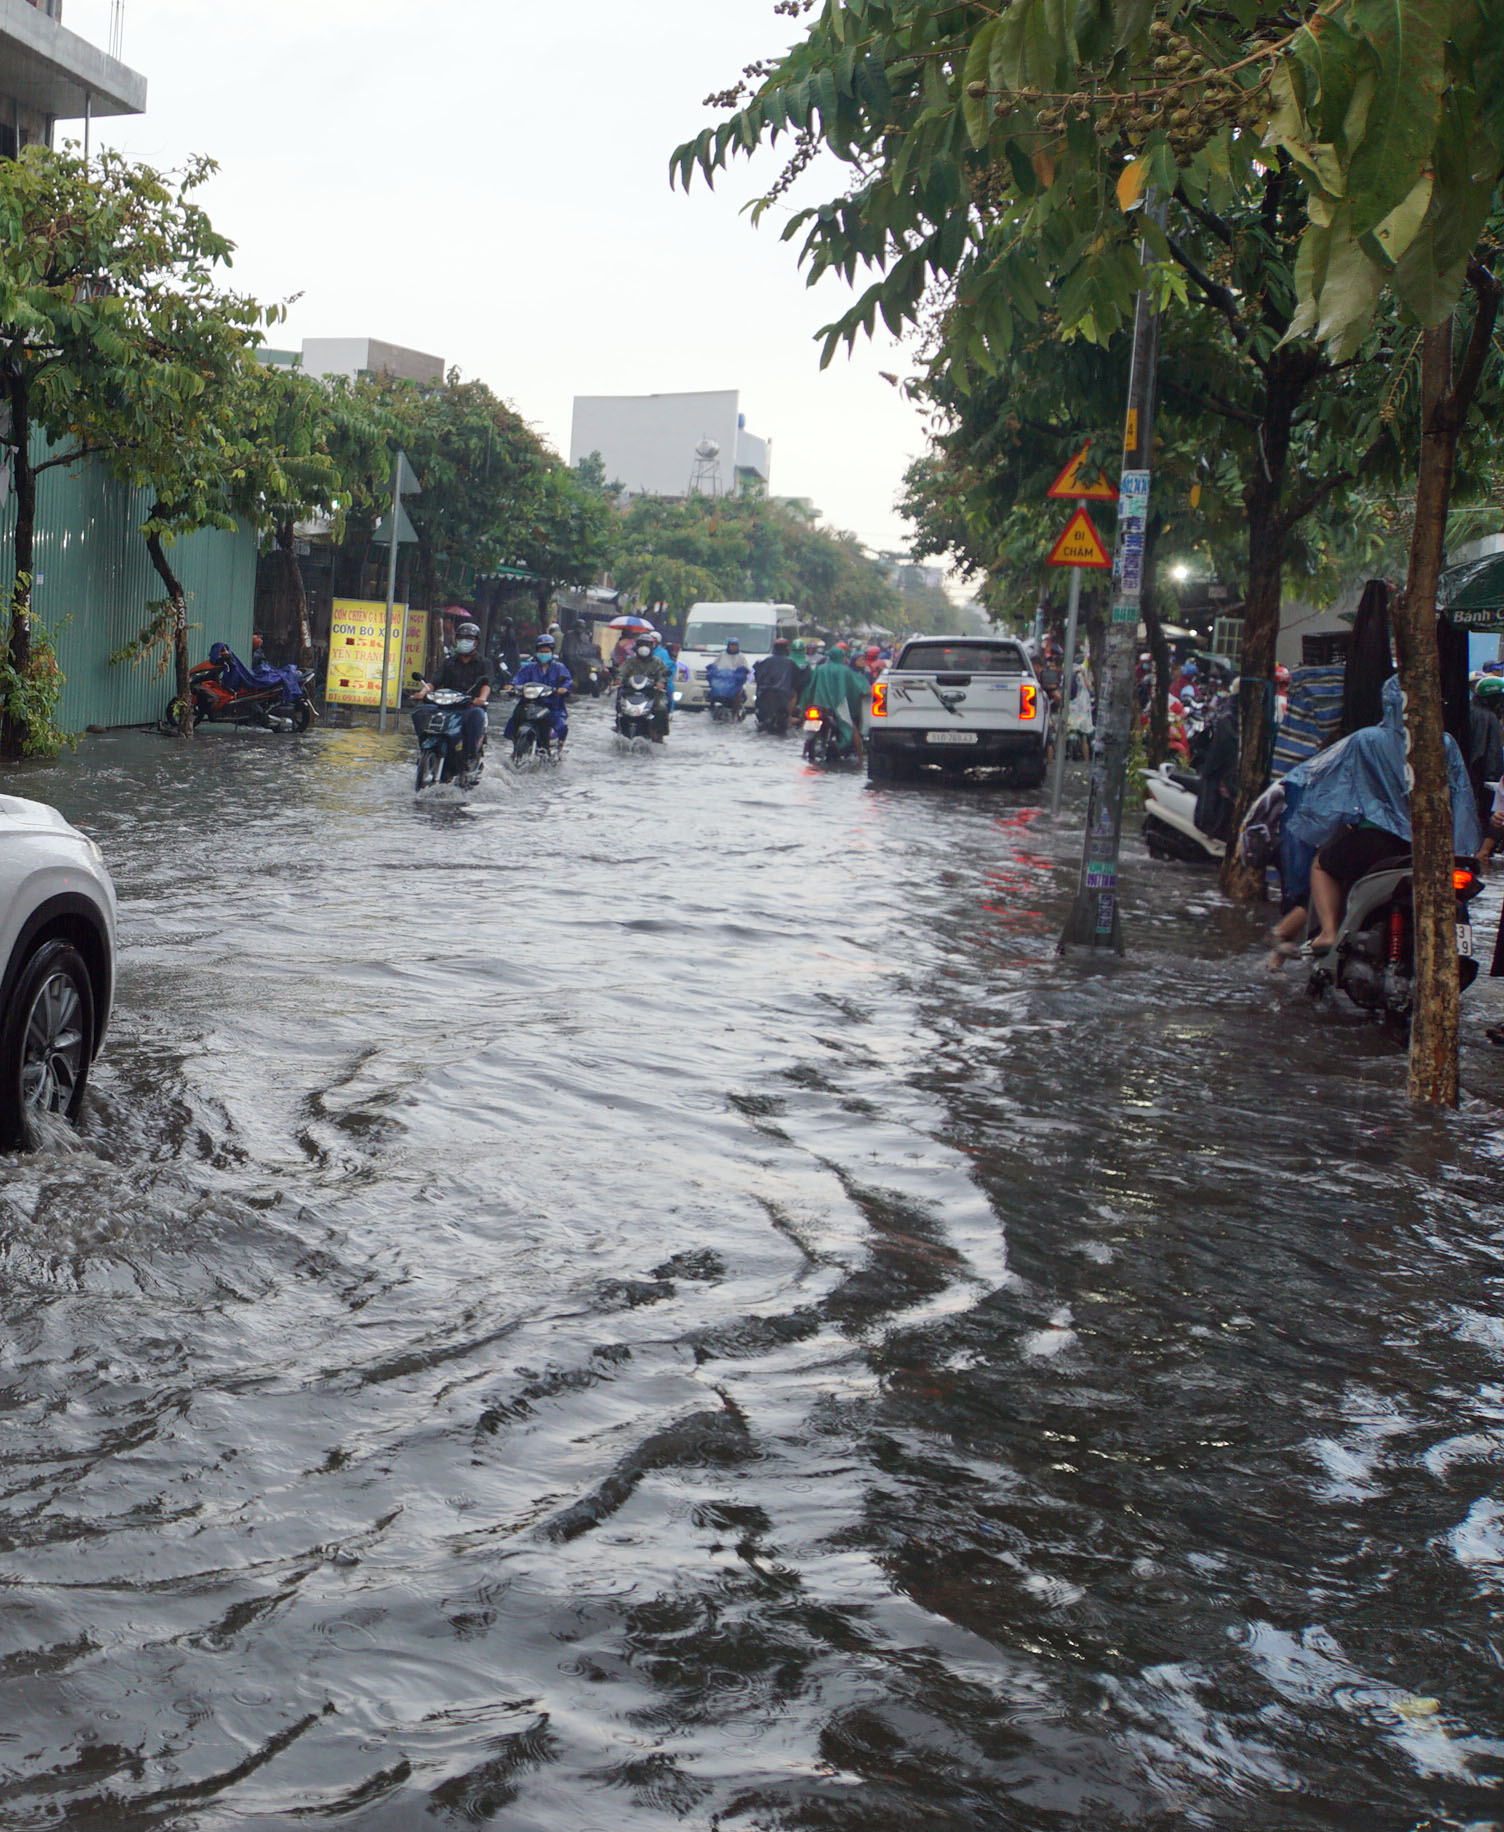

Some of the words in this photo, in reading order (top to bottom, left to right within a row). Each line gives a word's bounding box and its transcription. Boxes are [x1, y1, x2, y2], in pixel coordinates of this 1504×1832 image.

[1454, 608, 1490, 623] Bánh
[333, 623, 356, 635] CƠM
[378, 627, 400, 639] XO
